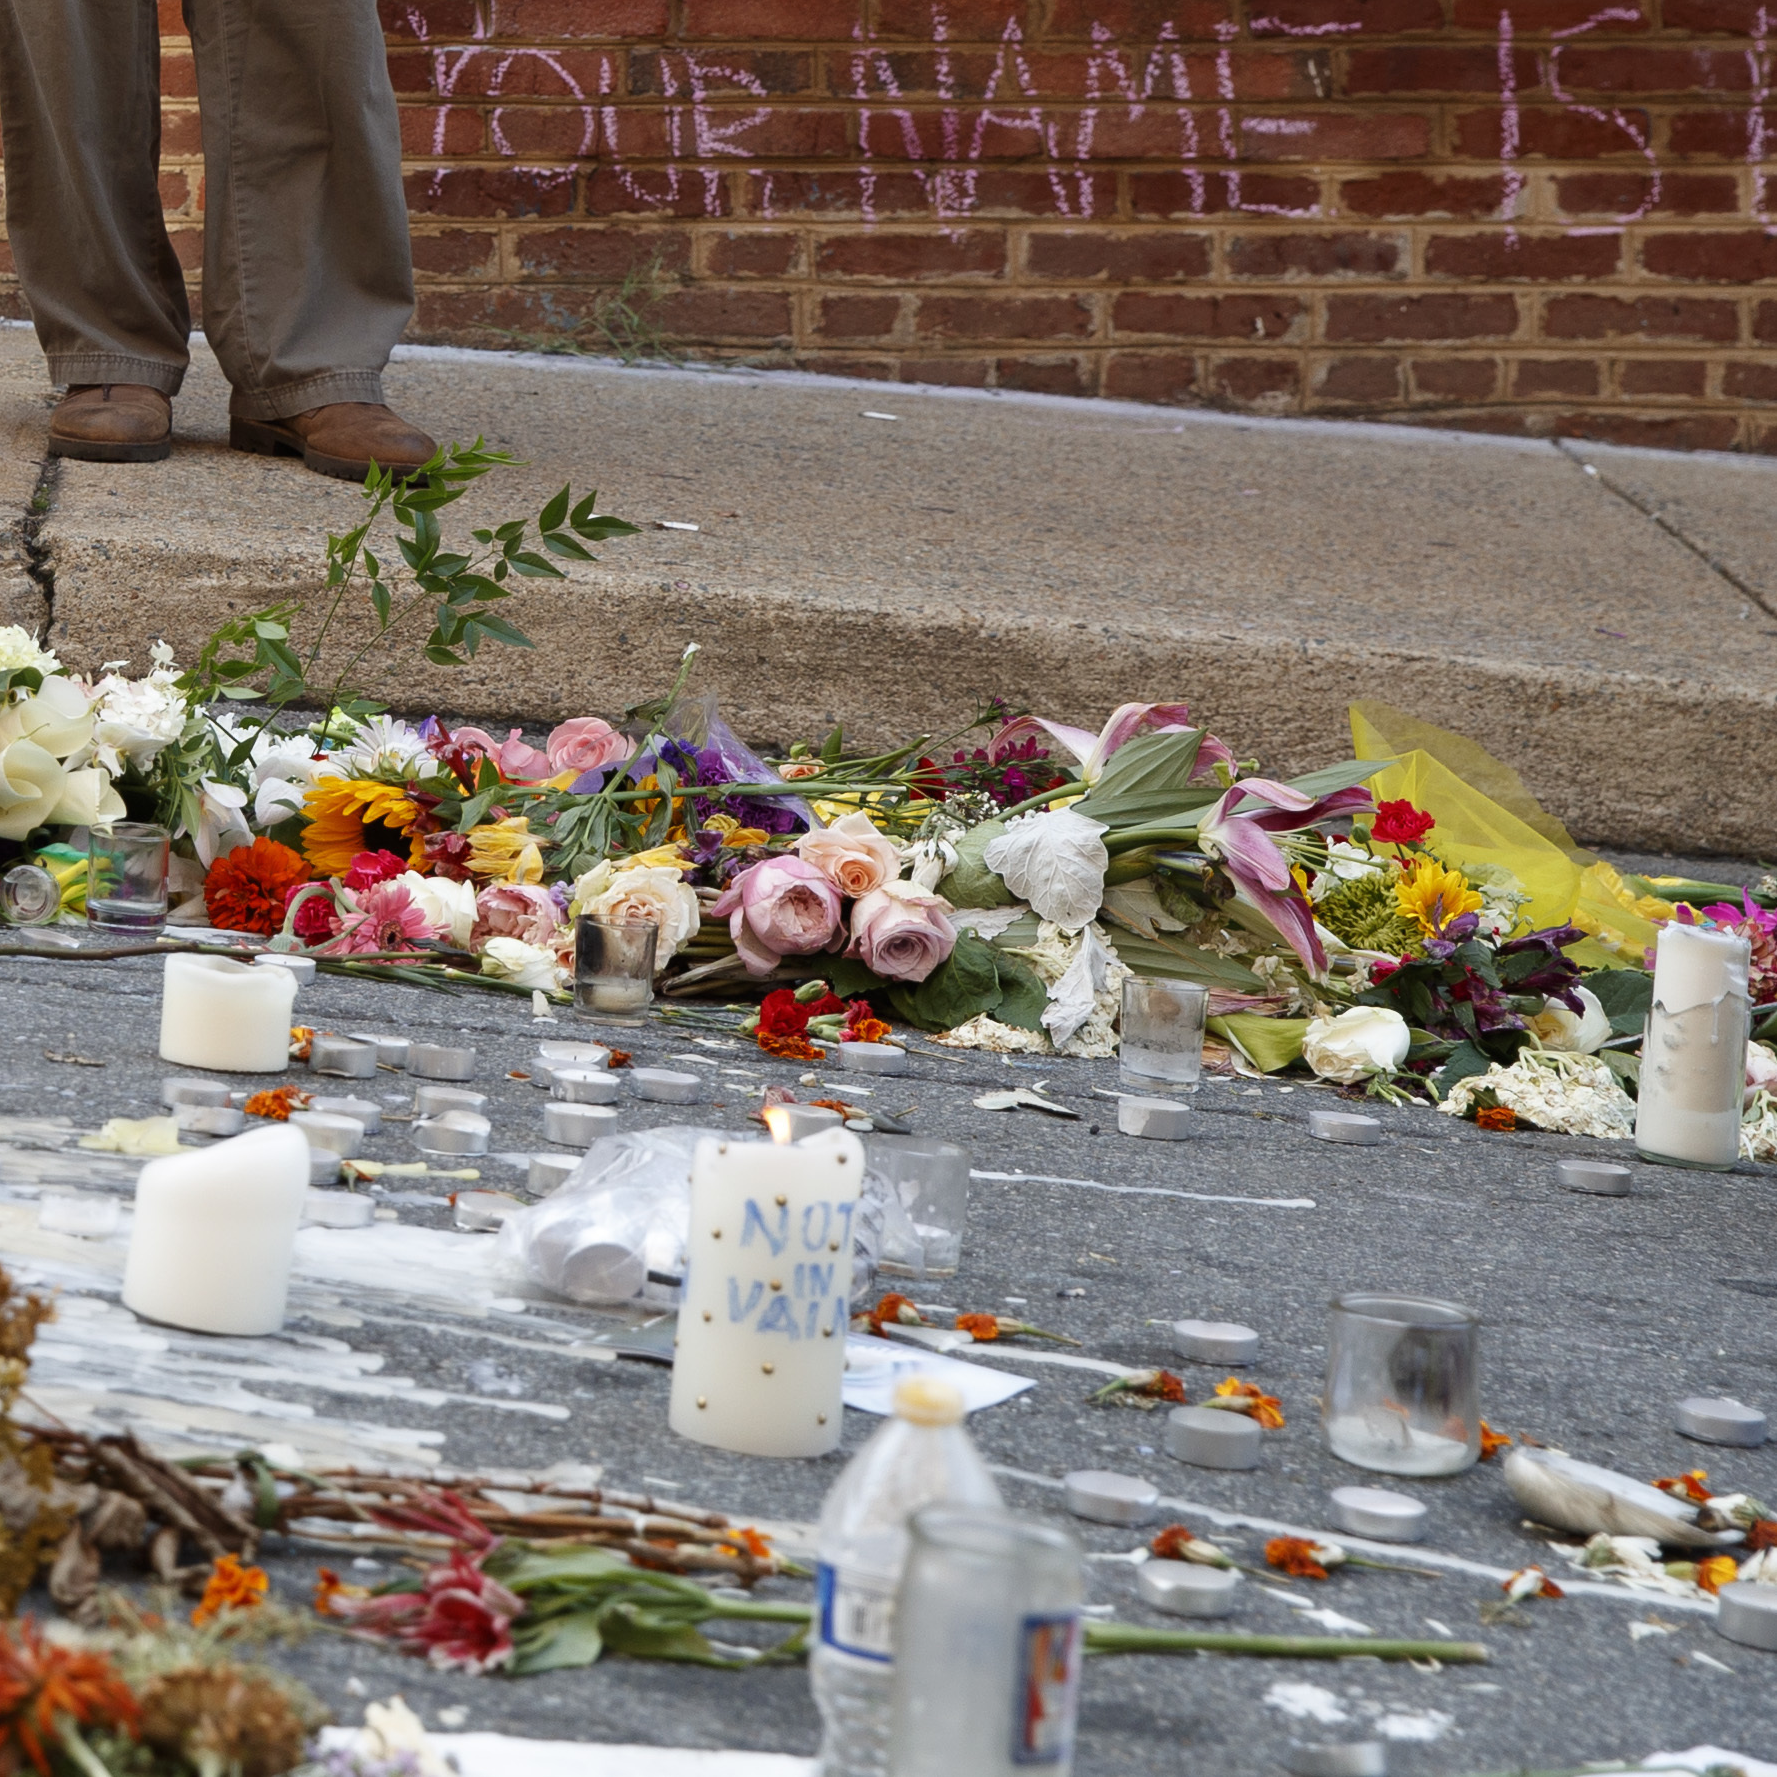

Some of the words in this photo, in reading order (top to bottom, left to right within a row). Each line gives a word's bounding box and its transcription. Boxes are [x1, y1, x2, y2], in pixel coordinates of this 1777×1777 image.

[849, 3, 1363, 237] NAME
[1497, 7, 1663, 252] IS
[740, 1197, 855, 1257] NOT
[726, 1275, 849, 1341] VAIN
[793, 1261, 836, 1301] IN
